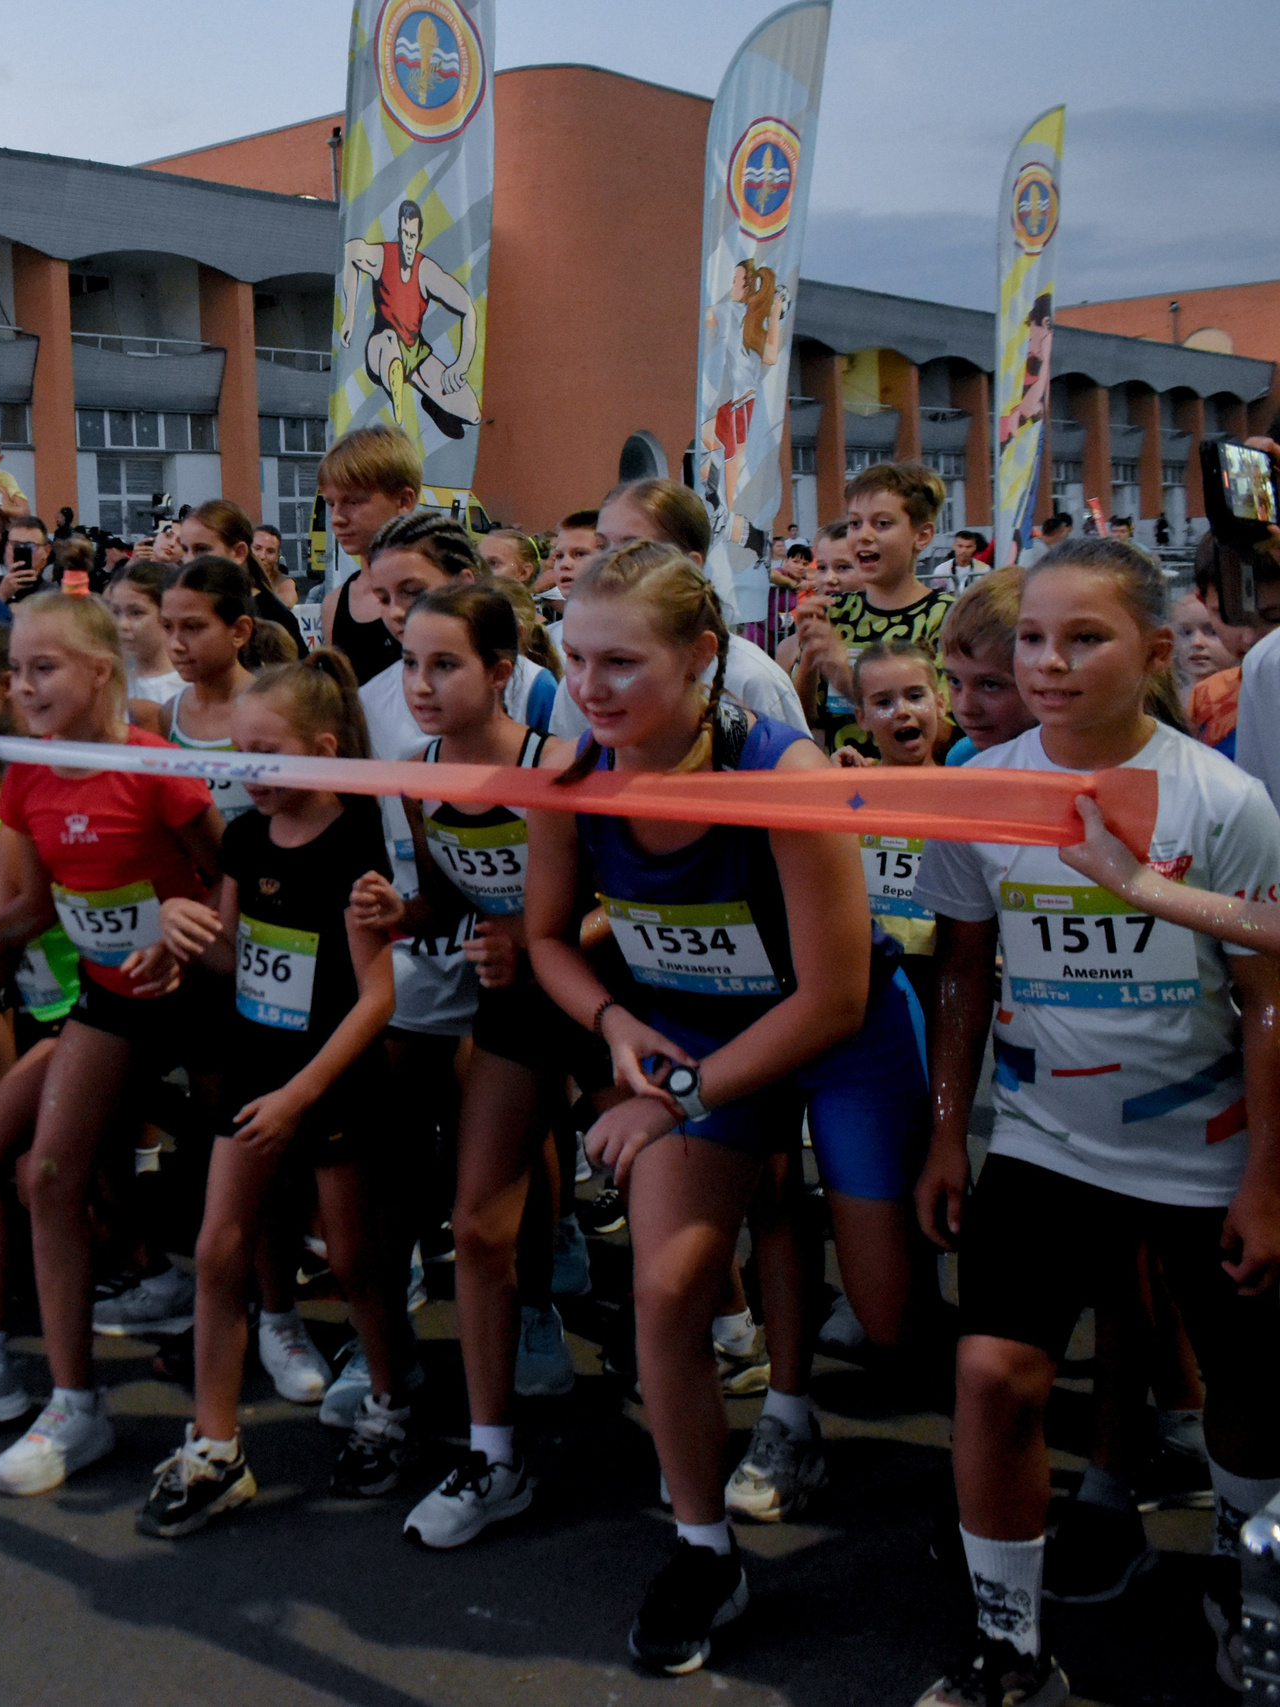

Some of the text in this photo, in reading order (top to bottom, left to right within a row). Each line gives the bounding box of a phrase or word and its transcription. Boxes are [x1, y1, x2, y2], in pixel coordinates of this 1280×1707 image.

[442, 846, 521, 876] 1533
[876, 851, 921, 878] 15
[882, 884, 913, 898] Веро
[71, 906, 138, 933] 1557
[633, 924, 737, 955] 1534
[1032, 916, 1155, 953] 1517
[657, 958, 732, 975] Елизавета
[1063, 964, 1133, 979] Амелия
[1120, 985, 1157, 1004] 1,5
